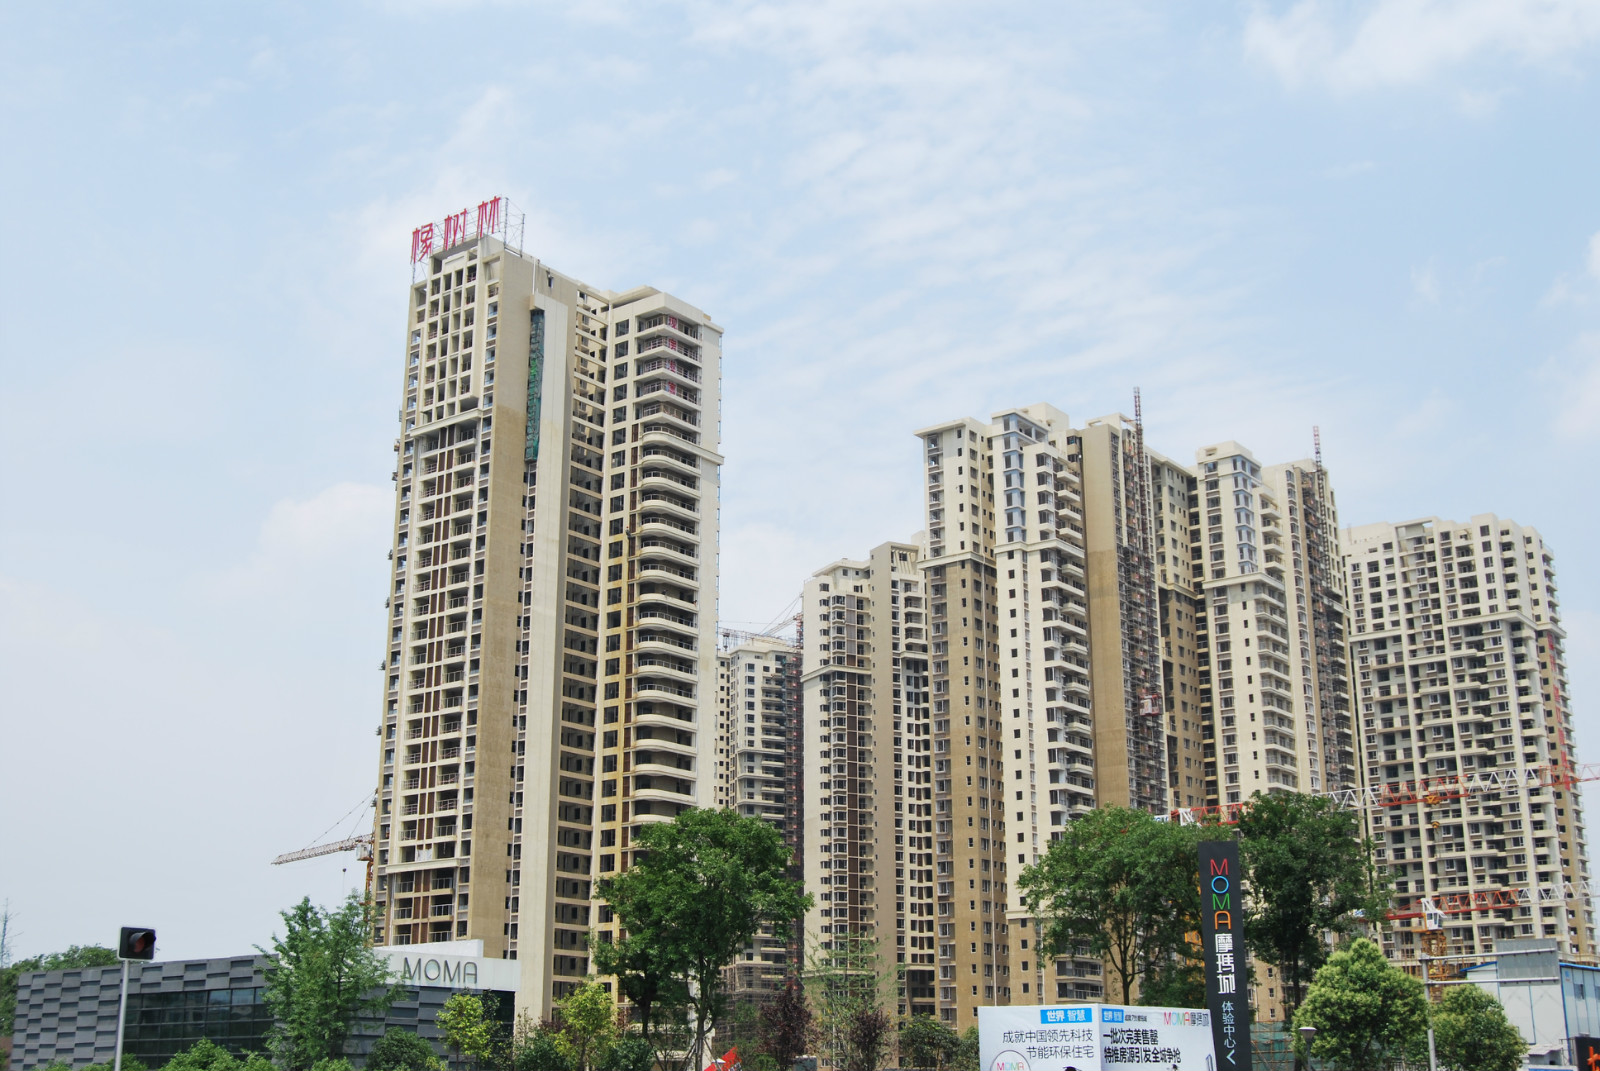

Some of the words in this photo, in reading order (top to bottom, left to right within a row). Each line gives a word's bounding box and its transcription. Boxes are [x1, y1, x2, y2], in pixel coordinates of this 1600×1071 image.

[410, 195, 501, 264] 橡树林
[1210, 858, 1232, 930] MOMA
[403, 957, 478, 985] MOMA
[1047, 1010, 1065, 1022] 世界
[1067, 1010, 1086, 1021] 智慧
[1221, 1000, 1237, 1049] 体验中心
[1003, 1029, 1093, 1043] 成就中国领先科技
[1103, 1028, 1159, 1045] 一批次完美售罄
[1026, 1045, 1094, 1059] 节能环保住宅
[1104, 1046, 1181, 1063] 特推房源引发全城争抢
[997, 1062, 1025, 1071] MOMA
